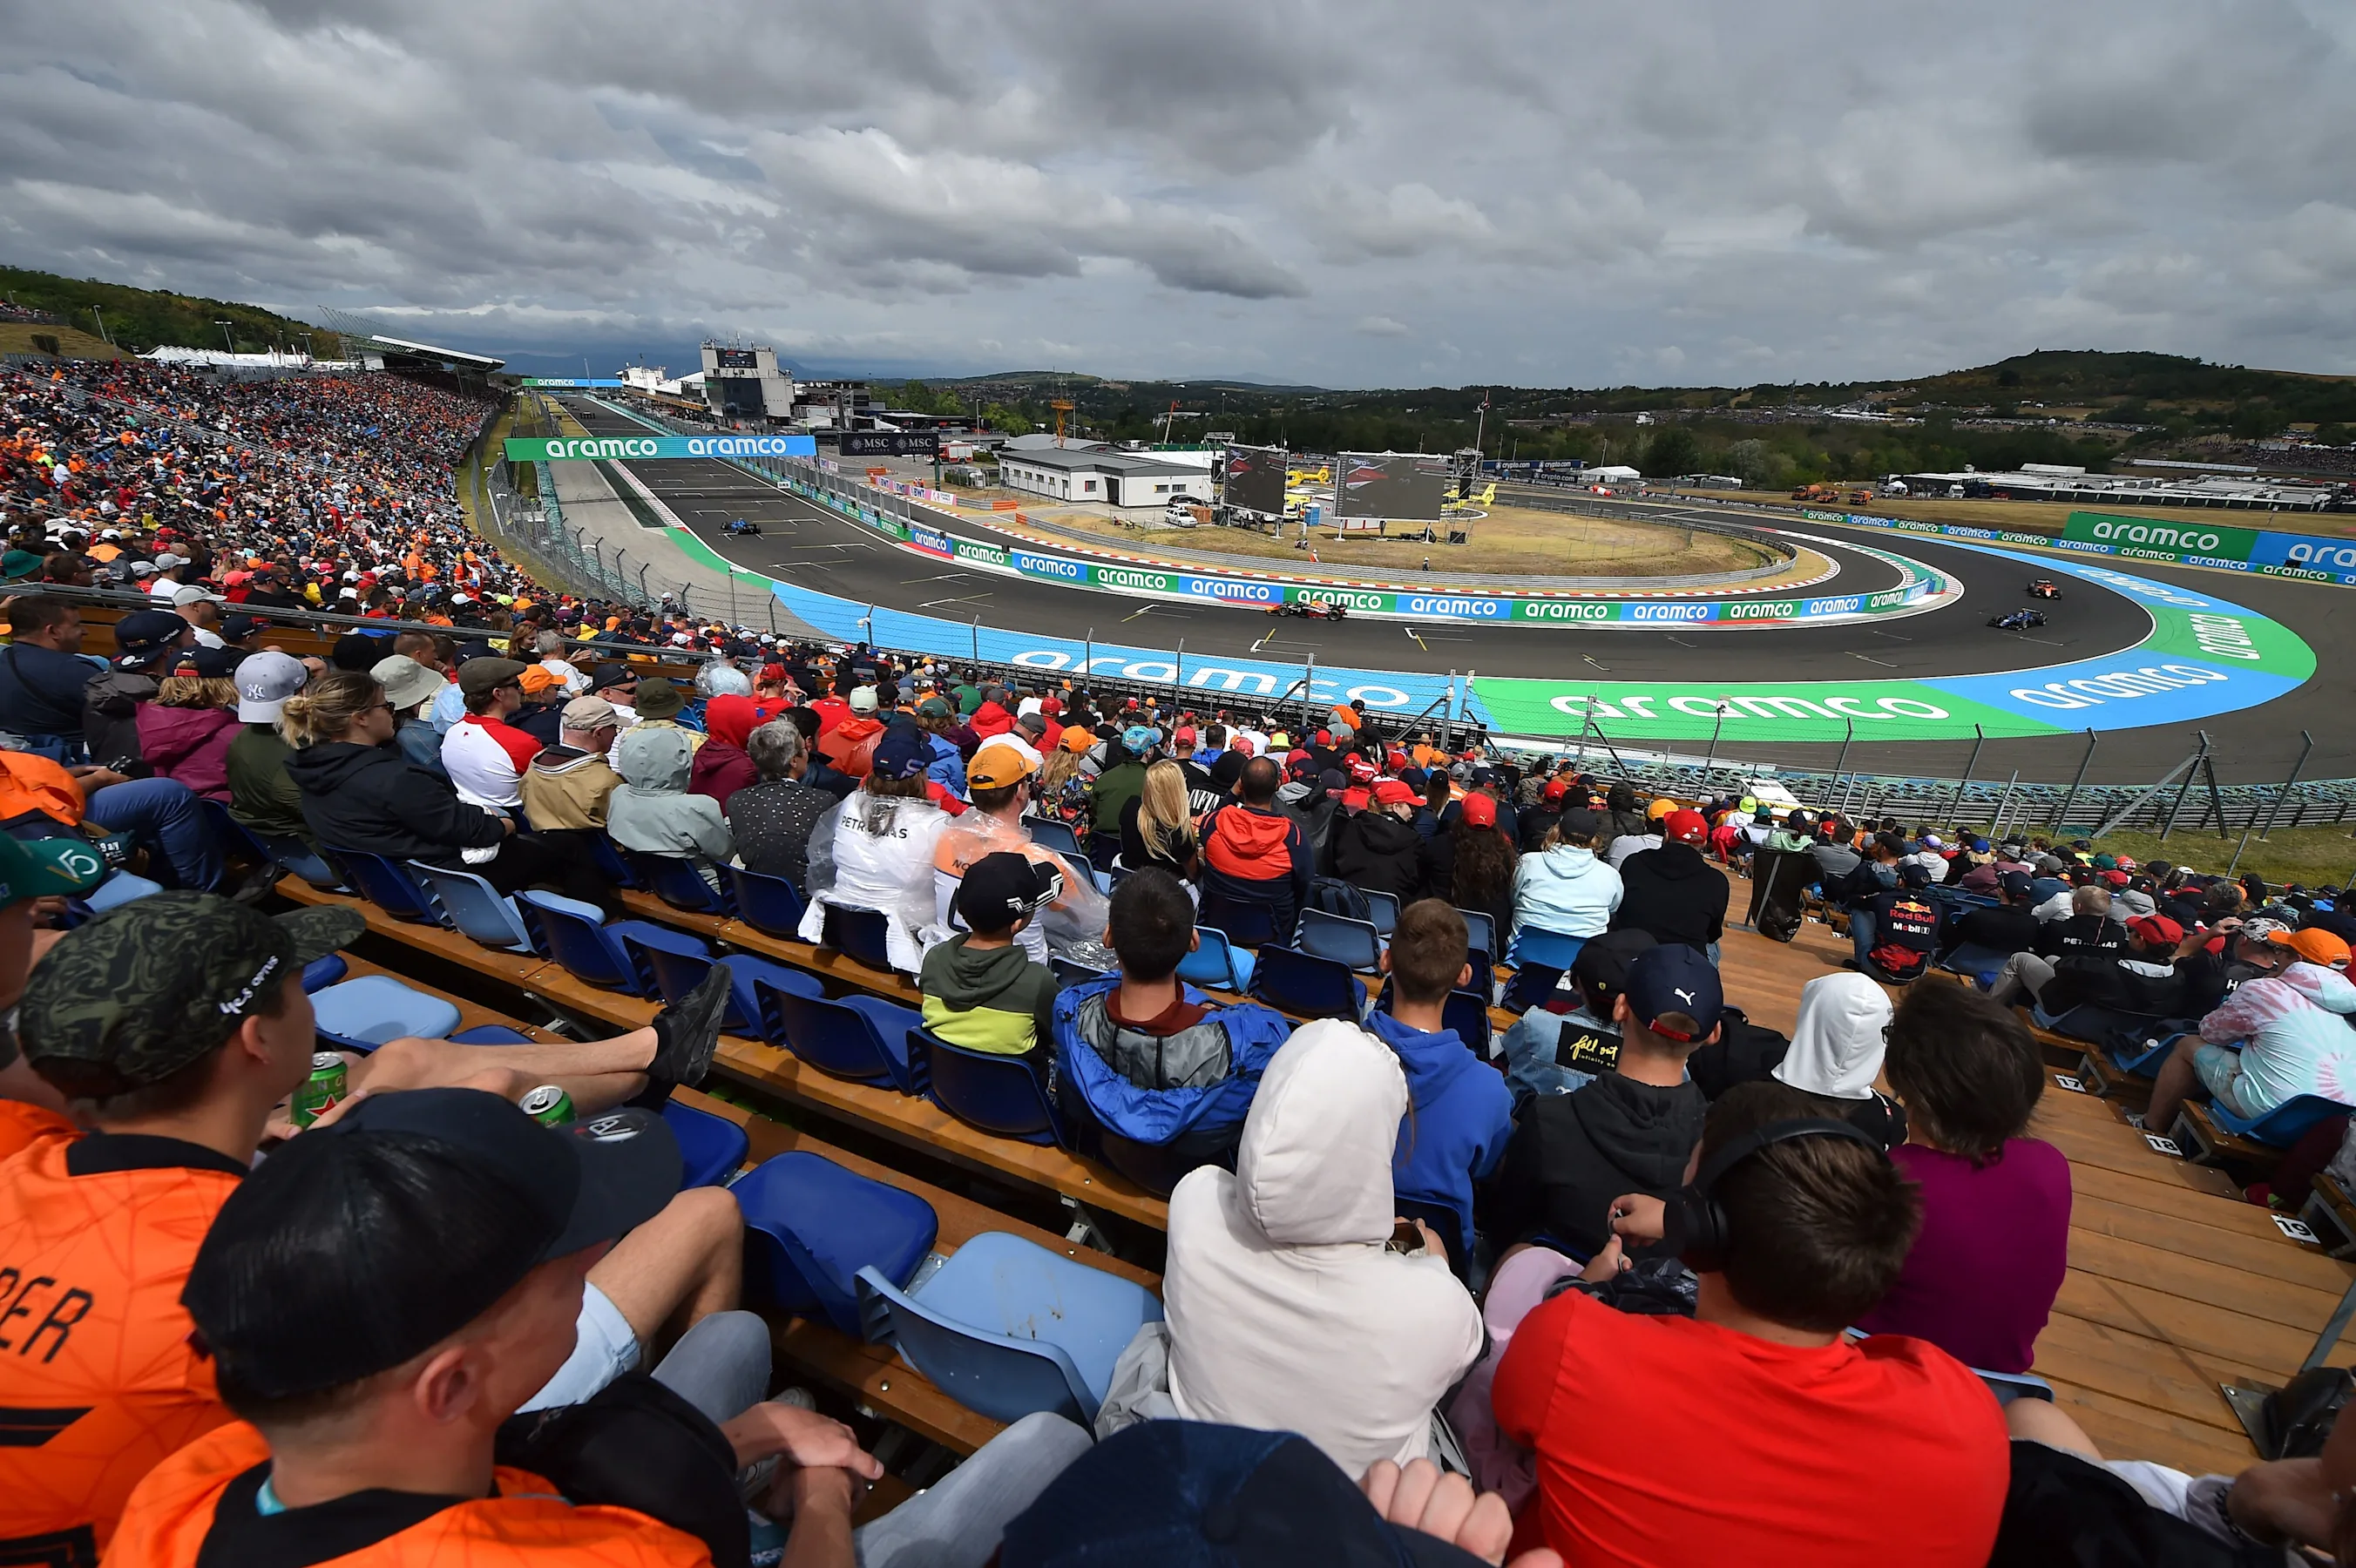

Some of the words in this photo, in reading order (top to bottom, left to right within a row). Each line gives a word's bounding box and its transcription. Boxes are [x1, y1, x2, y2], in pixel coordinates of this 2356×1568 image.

[545, 439, 658, 457] aramco
[687, 437, 787, 455] aramco
[864, 438, 889, 448] MSC
[909, 437, 932, 447] MSC
[1348, 457, 1366, 466] Claro
[1540, 473, 1574, 483] crypto.com
[913, 487, 924, 498] BWT
[1807, 510, 1844, 523] aramco
[1852, 515, 1890, 527] aramco
[1898, 520, 1939, 533] aramco
[1947, 527, 1991, 539] aramco
[915, 528, 947, 551] aramco
[2001, 532, 2048, 545] aramco
[2092, 521, 2220, 551] aramco
[958, 541, 1005, 564] aramco
[2059, 539, 2109, 553] aramco
[2121, 546, 2176, 562] aramco
[1021, 556, 1077, 577] aramco
[2188, 556, 2248, 571] aramco
[1098, 568, 1167, 590] aramco
[2263, 564, 2328, 581] aramco
[1191, 580, 1269, 600] aramco
[2076, 569, 2210, 607] aramco
[1297, 589, 1382, 610] aramco
[1810, 598, 1858, 614] aramco
[1870, 590, 1904, 608] aramco
[1411, 598, 1497, 617] aramco
[1524, 602, 1608, 619] aramco
[1633, 602, 1709, 619] aramco
[1730, 603, 1793, 618] aramco
[2188, 612, 2262, 660] aramco
[1011, 650, 1412, 706] aramco
[247, 683, 265, 699] NY
[2008, 663, 2230, 710] aramco
[1549, 694, 1951, 720] aramco
[840, 815, 908, 839] PETRAS
[1889, 909, 1913, 920] Red
[1914, 913, 1936, 924] Bull
[1892, 922, 1920, 934] Mobil
[1569, 1035, 1599, 1060] fall
[1600, 1045, 1619, 1061] out
[1578, 1052, 1604, 1064] infinity
[2058, 1078, 2080, 1088] 17
[2148, 1138, 2178, 1151] 18
[2276, 1220, 2312, 1236] 19
